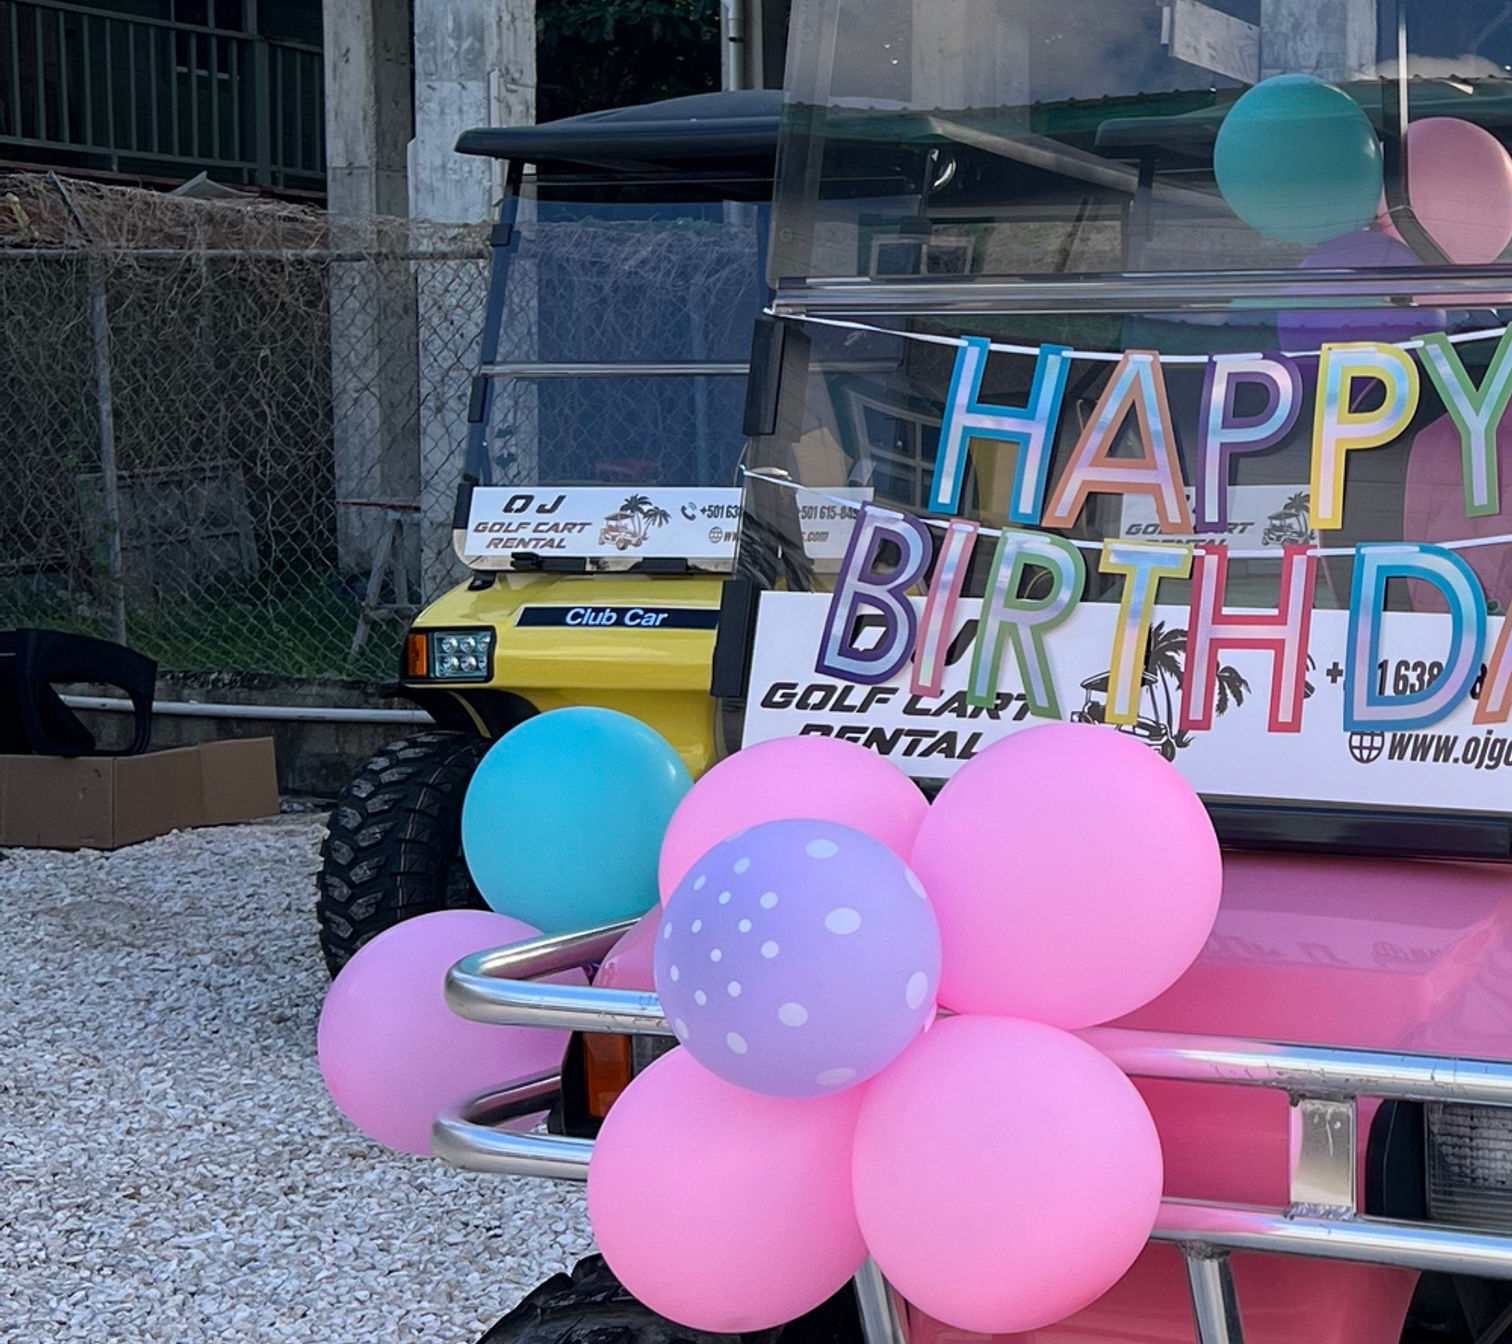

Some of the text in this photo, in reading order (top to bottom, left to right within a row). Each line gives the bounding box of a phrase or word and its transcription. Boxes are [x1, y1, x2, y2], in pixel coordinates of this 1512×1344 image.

[473, 522, 592, 533] GOLF CART
[486, 537, 566, 549] RENTAL
[565, 607, 668, 626] Club Car
[760, 681, 900, 714] GOLF
